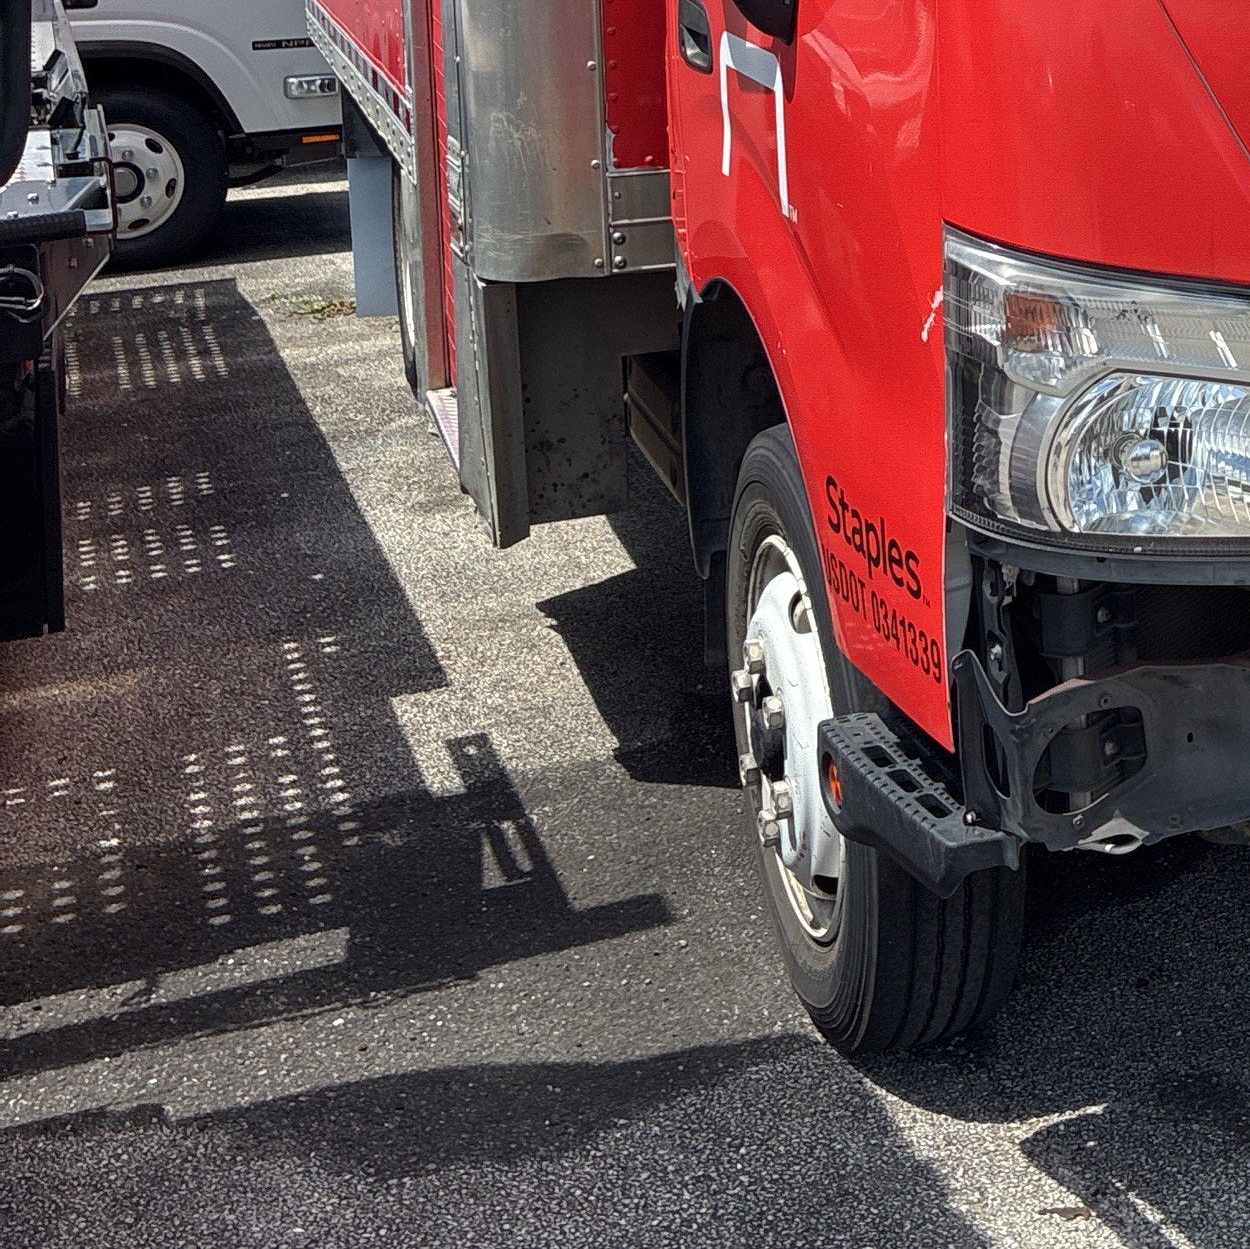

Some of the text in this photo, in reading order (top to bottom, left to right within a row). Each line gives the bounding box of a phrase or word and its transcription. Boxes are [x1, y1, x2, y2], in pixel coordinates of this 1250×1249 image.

[824, 474, 923, 600] Staples
[822, 542, 942, 685] USDOT 0341339
